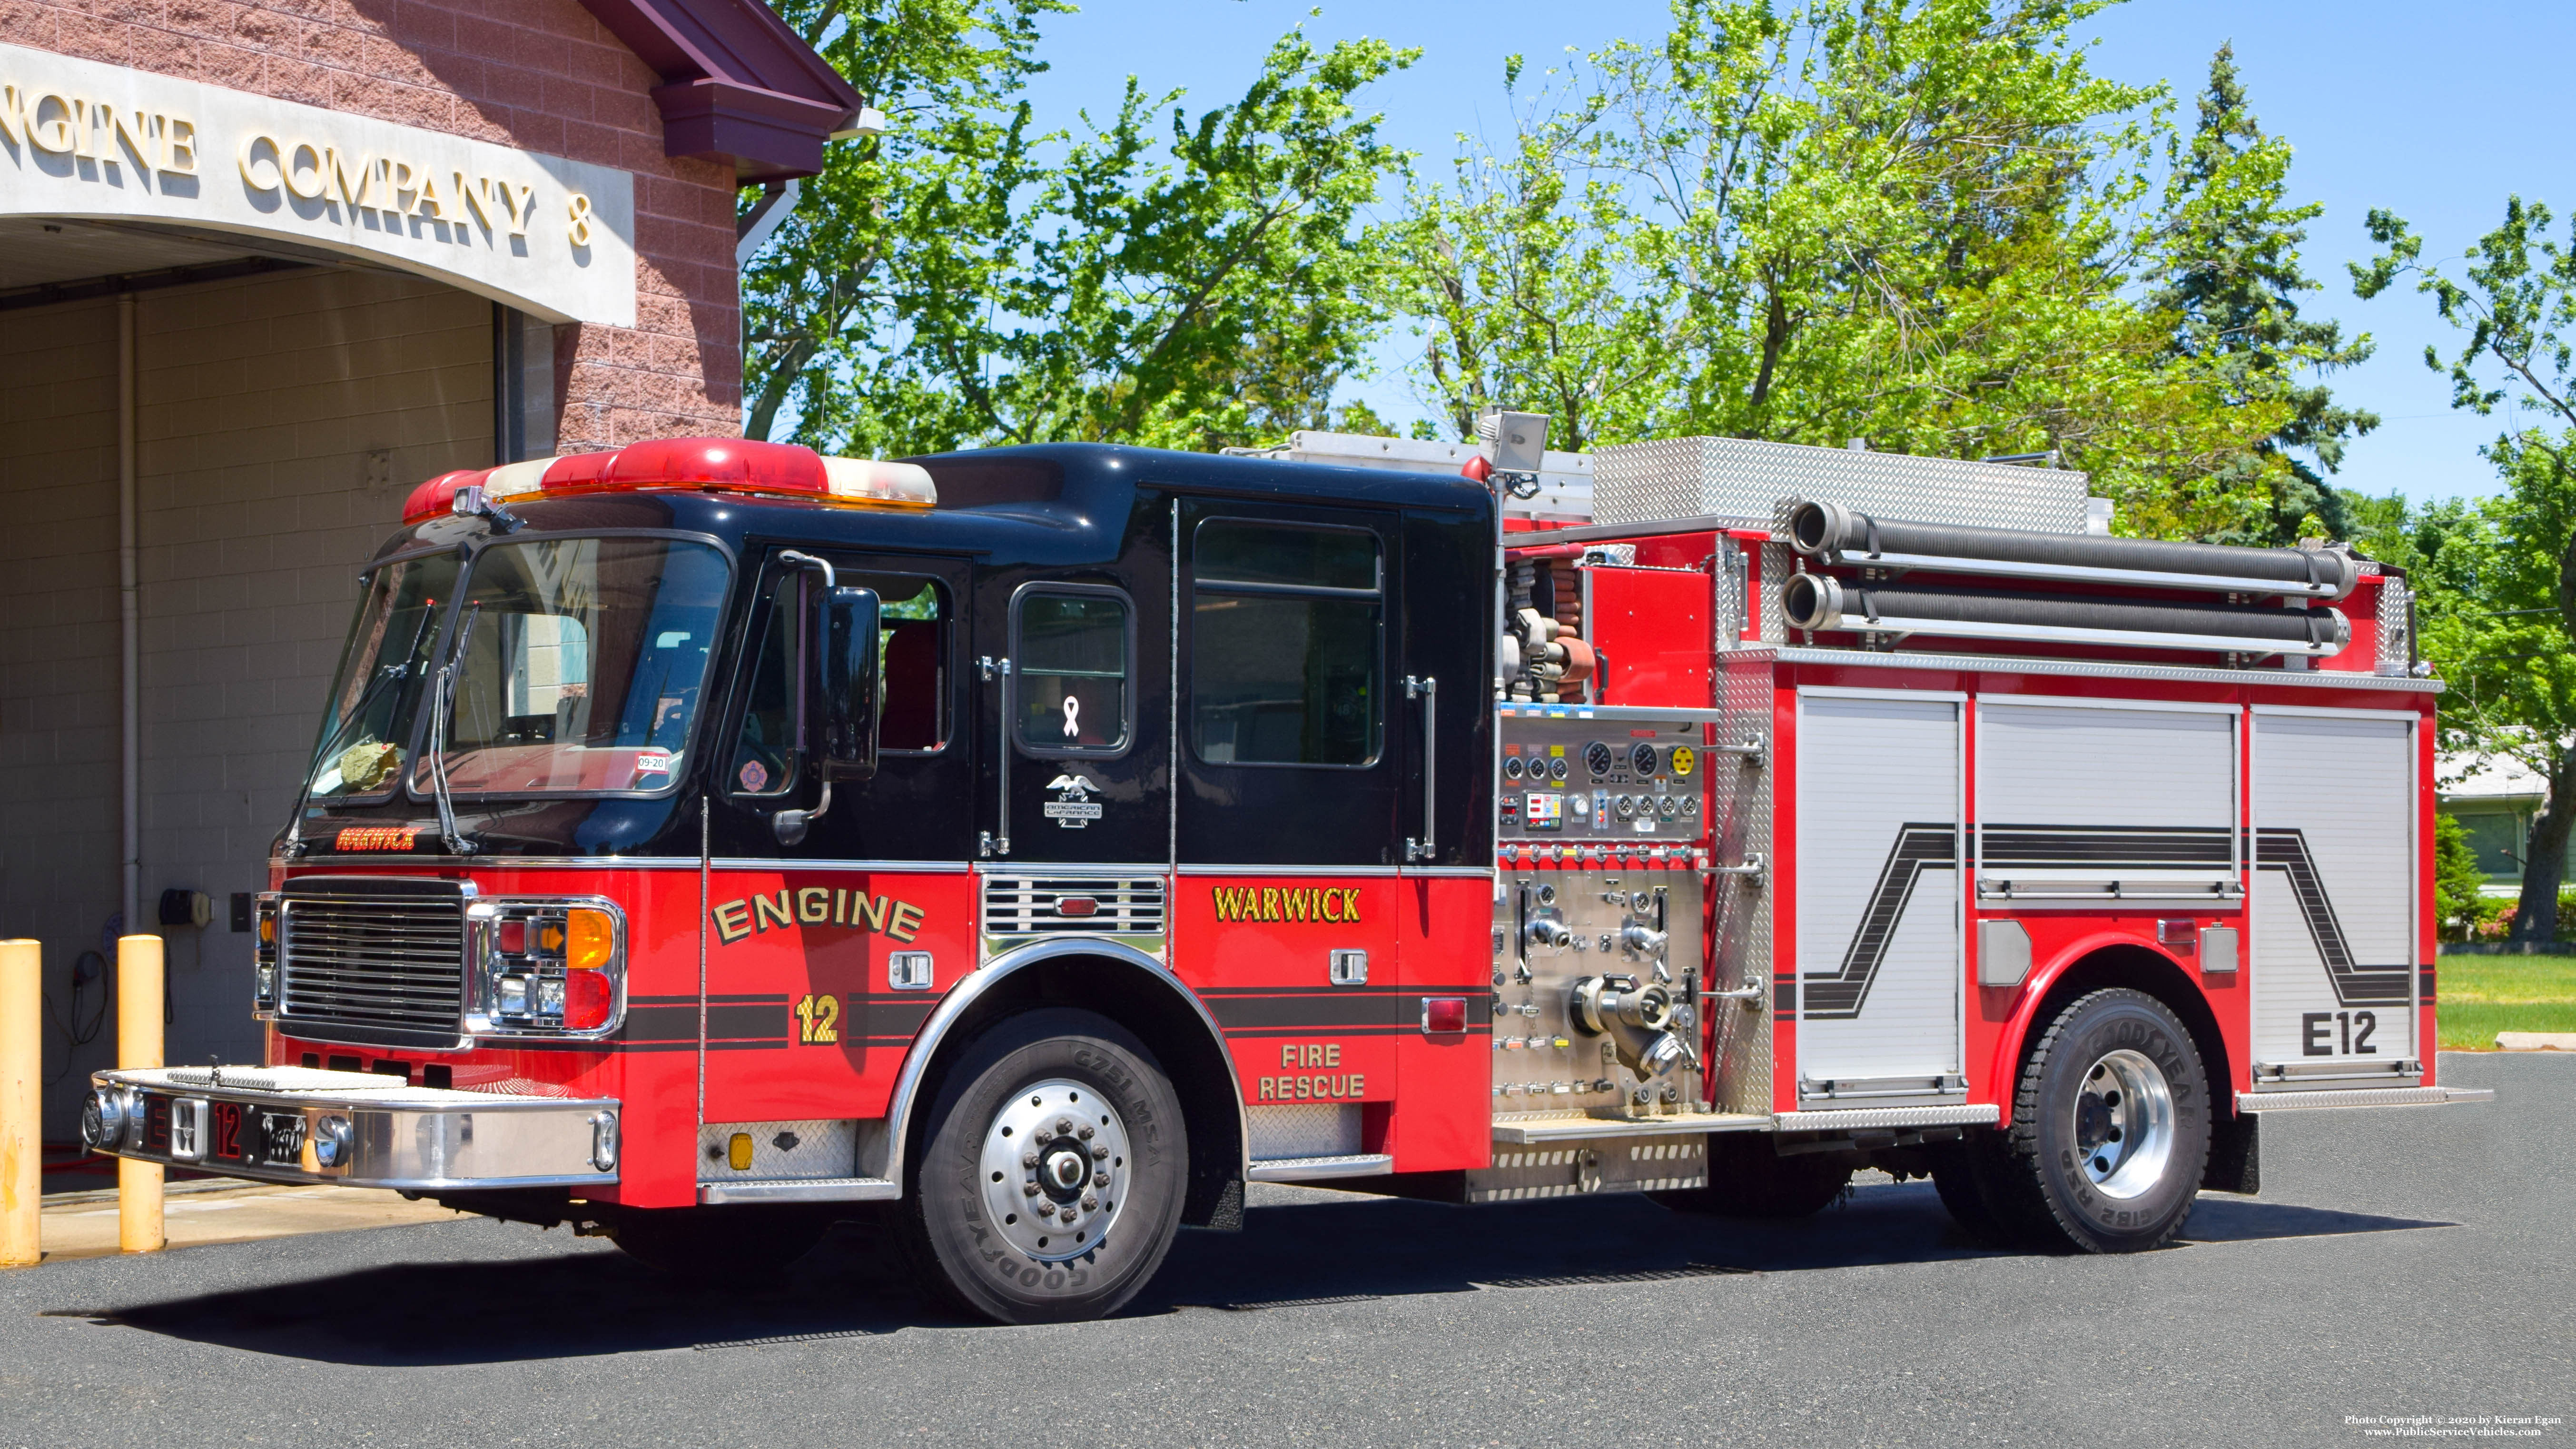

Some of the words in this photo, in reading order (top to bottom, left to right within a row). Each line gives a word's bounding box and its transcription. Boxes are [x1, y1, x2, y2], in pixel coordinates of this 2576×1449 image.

[238, 132, 537, 236] COMPANY
[569, 192, 592, 247] 8
[639, 757, 663, 767] 09-20
[336, 827, 425, 851] WARWICK
[711, 887, 925, 946] ENGINE
[1212, 886, 1362, 923] WARWICK
[794, 994, 839, 1046] 12
[2302, 1011, 2377, 1056] E12
[1281, 1043, 1341, 1069] FIRE
[1074, 1049, 1133, 1091] G751
[1132, 1099, 1161, 1167] MSA
[1258, 1074, 1365, 1101] RESCUE
[148, 1097, 168, 1148] E
[215, 1103, 242, 1158] 12
